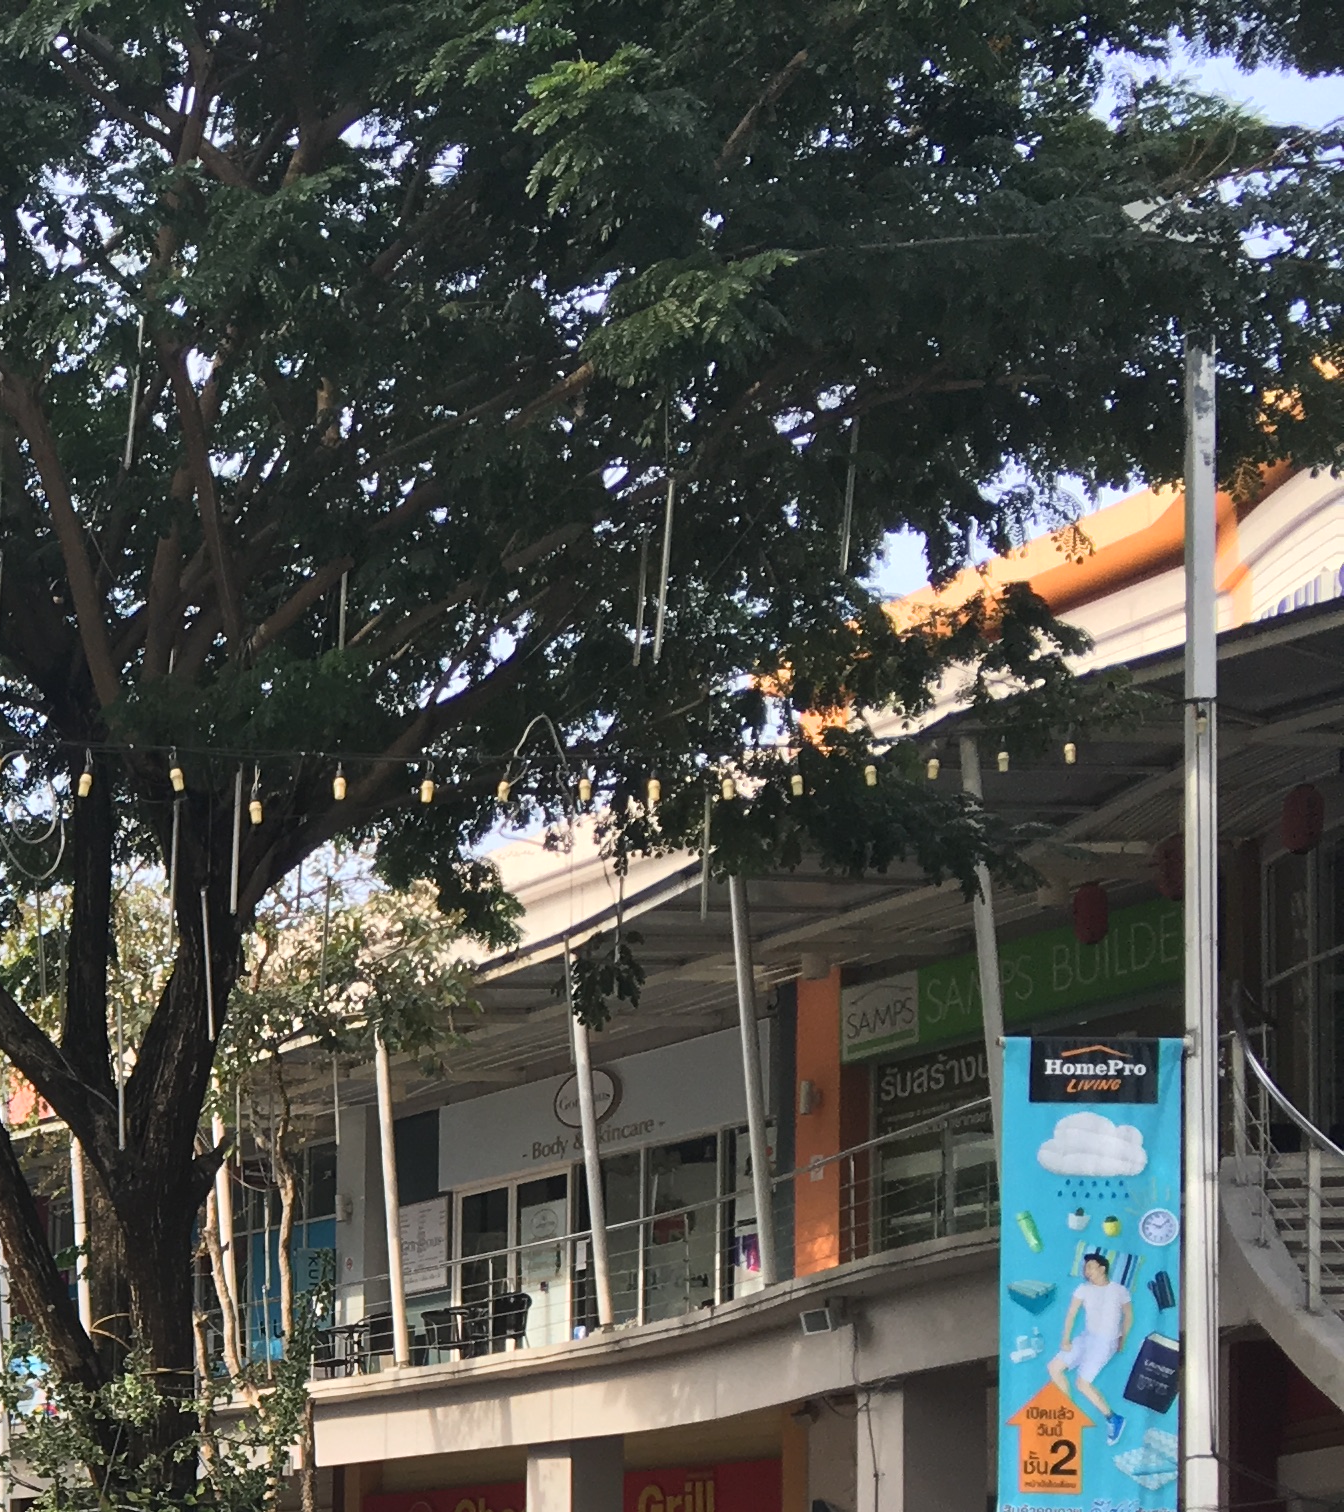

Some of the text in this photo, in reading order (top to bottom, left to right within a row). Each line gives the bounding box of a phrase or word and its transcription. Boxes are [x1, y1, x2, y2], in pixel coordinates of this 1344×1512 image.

[846, 997, 915, 1040] SAMPS
[1044, 1058, 1147, 1077] HomePro
[1066, 1078, 1122, 1093] LIVING
[531, 1135, 569, 1160] Body
[595, 1118, 655, 1145] kincare
[1026, 1406, 1075, 1421] เปิดแล้ว
[1037, 1423, 1063, 1437] วันนี้
[1023, 1439, 1078, 1476] ชั้น 2
